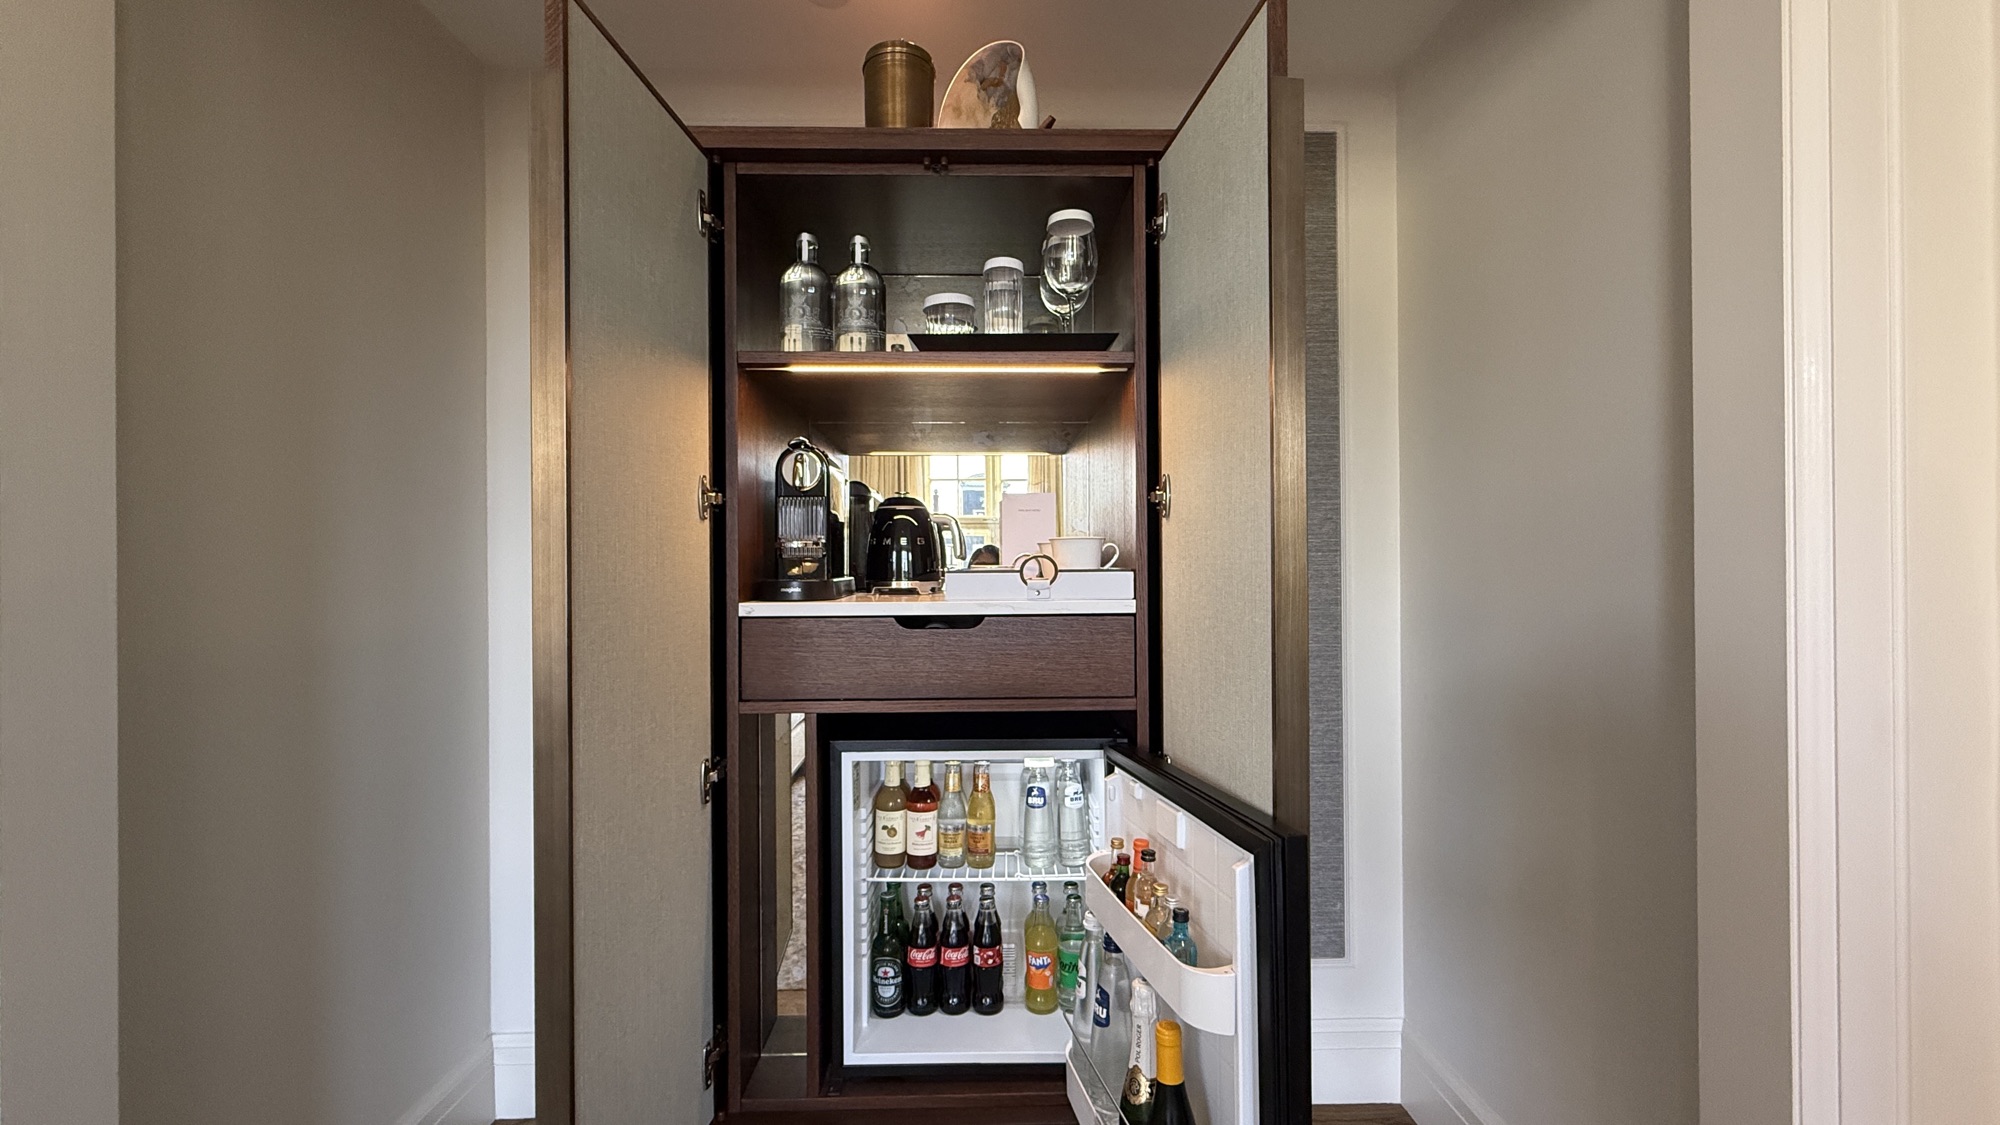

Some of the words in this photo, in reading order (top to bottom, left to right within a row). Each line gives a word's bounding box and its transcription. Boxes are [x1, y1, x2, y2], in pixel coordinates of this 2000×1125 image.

[910, 947, 936, 961] Coca-Cola
[945, 945, 969, 961] Coca-Cola
[1060, 961, 1080, 975] prit
[872, 975, 902, 985] Heineken
[1094, 1002, 1107, 1019] RU
[1134, 1050, 1142, 1064] POL
